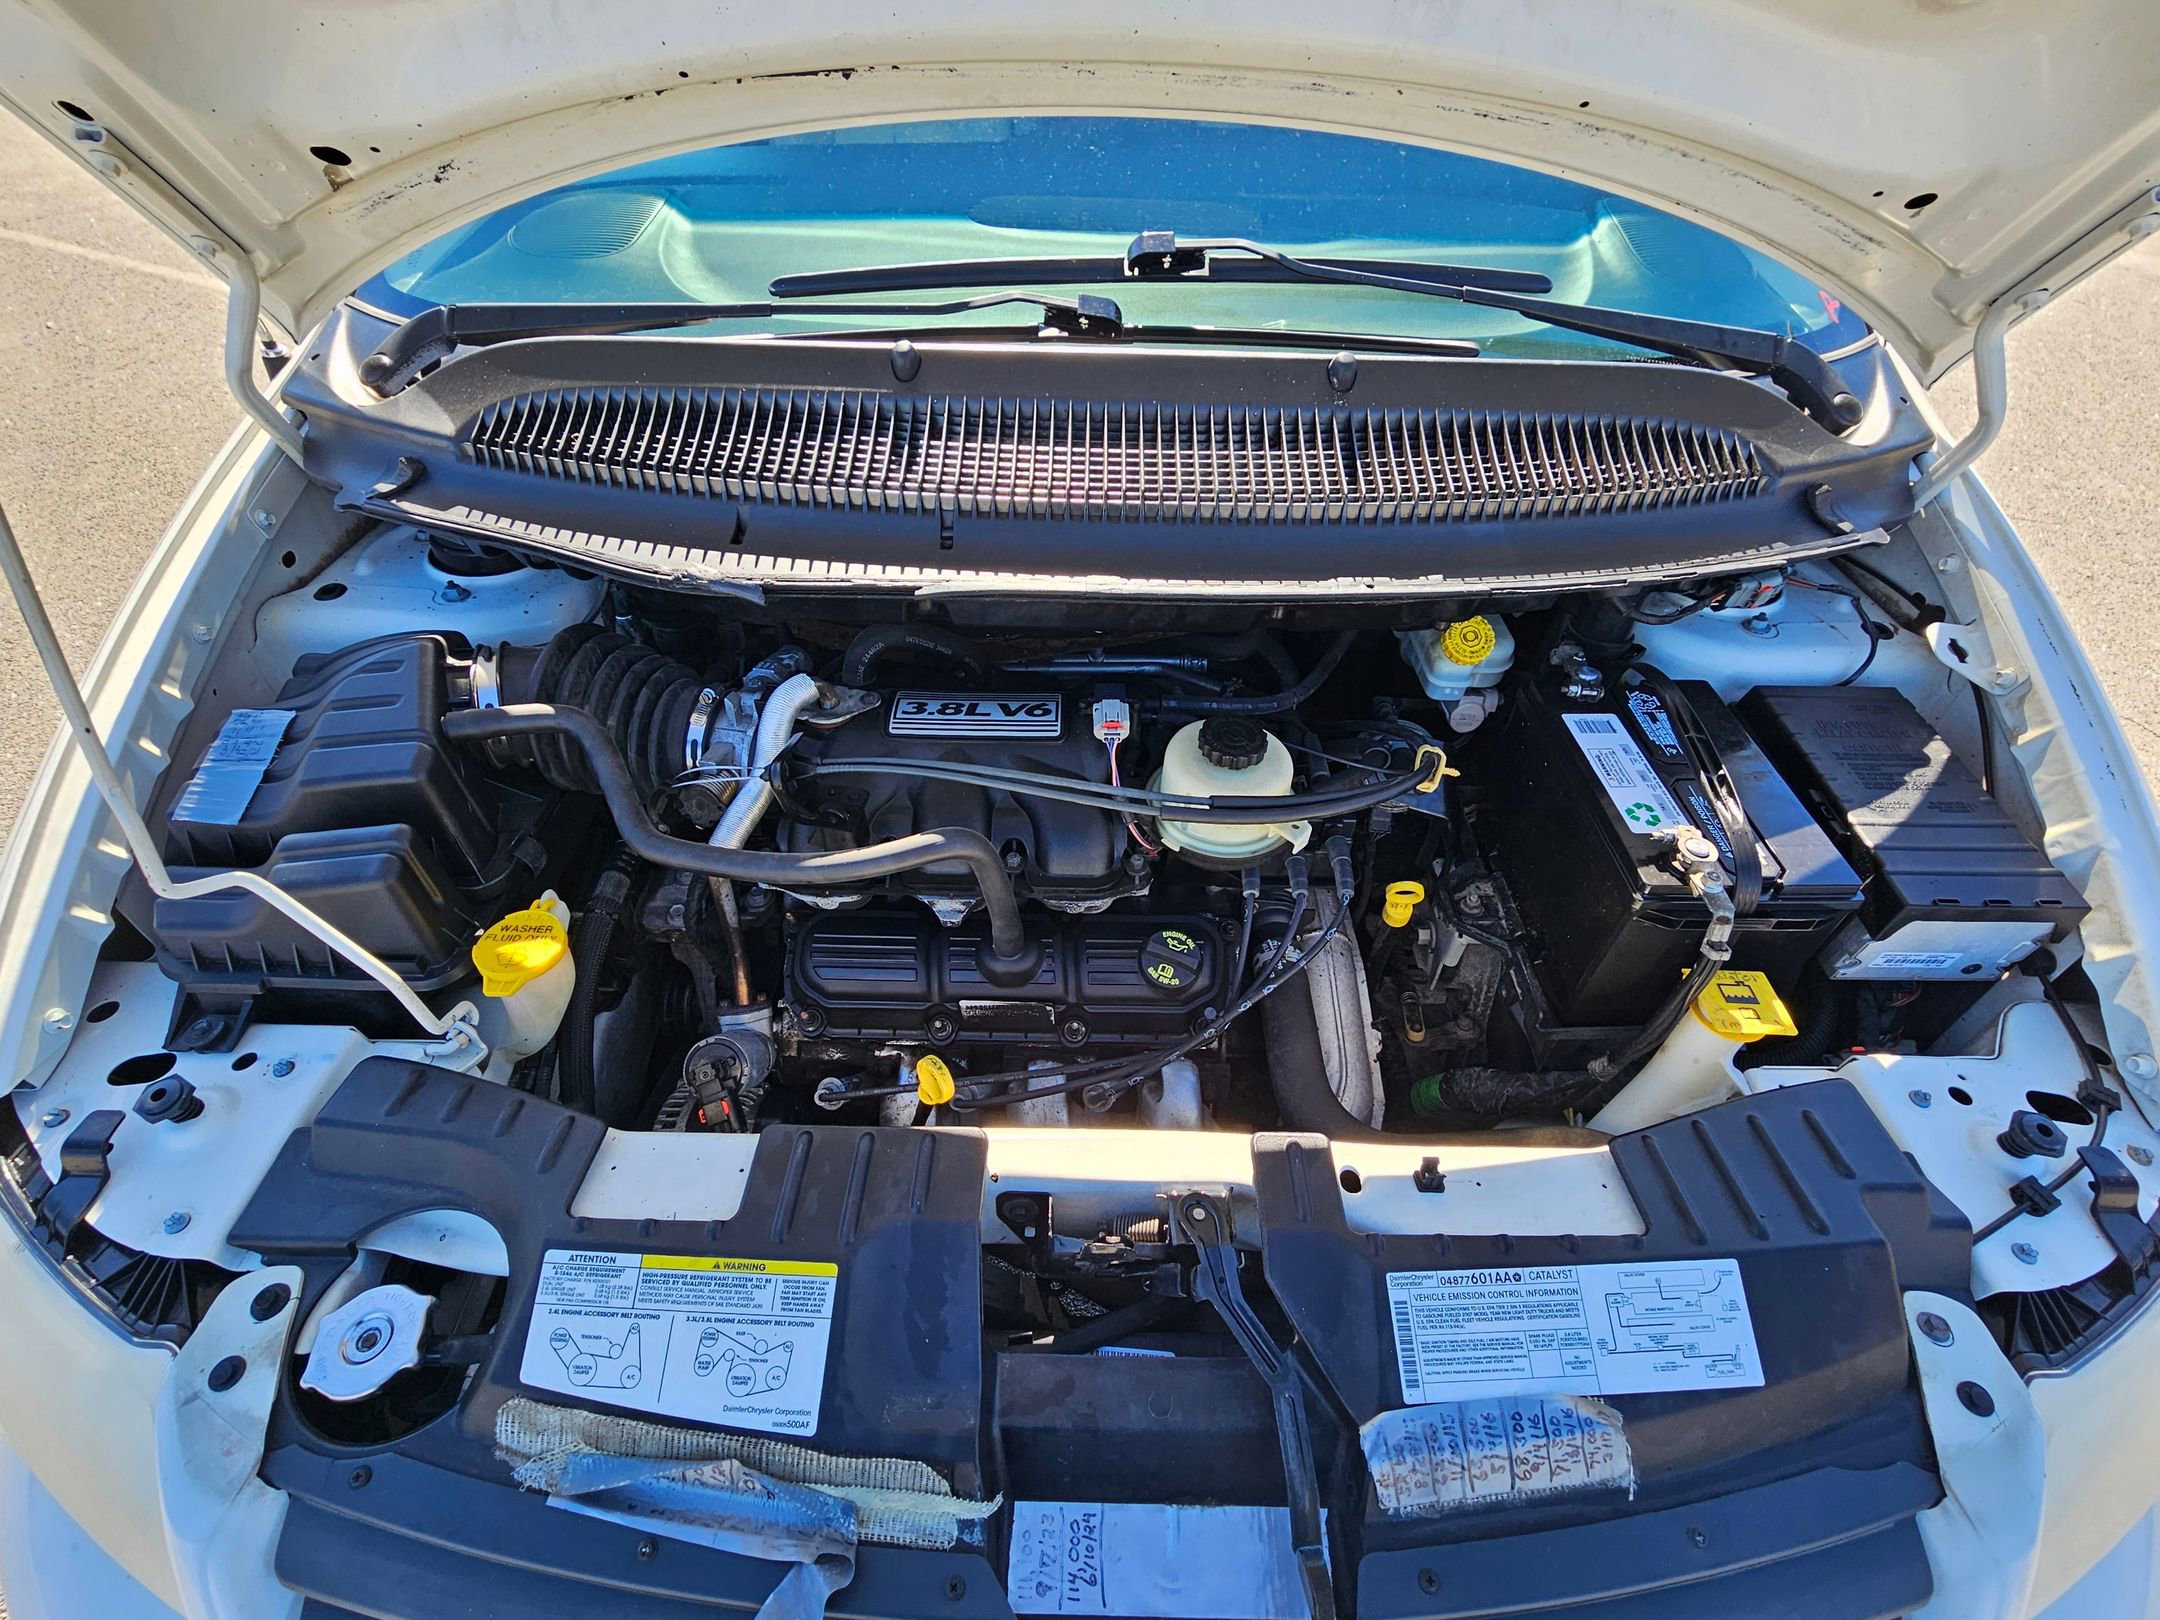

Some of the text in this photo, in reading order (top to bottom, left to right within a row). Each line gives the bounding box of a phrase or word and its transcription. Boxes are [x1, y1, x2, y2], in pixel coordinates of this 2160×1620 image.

[902, 701, 1053, 717] 3.8L V6
[1689, 796, 1707, 819] POISON
[1708, 823, 1728, 853] DANGER
[500, 925, 553, 933] WASHER
[485, 934, 521, 942] FLUID
[1162, 931, 1196, 950] ENGINE OIL
[1148, 967, 1179, 985] SAE 5W-20
[568, 1255, 616, 1264] ATTENTION
[723, 1262, 766, 1271] WARNING
[1529, 1270, 1573, 1280] CATALYST
[1413, 1288, 1578, 1301] VEHICLE EMISSION CONTROL INFORMATION
[723, 1405, 811, 1417] DaimlerChrysler Corporation
[1514, 1411, 1532, 1481] 68,300
[1066, 1519, 1086, 1602] 114,000
